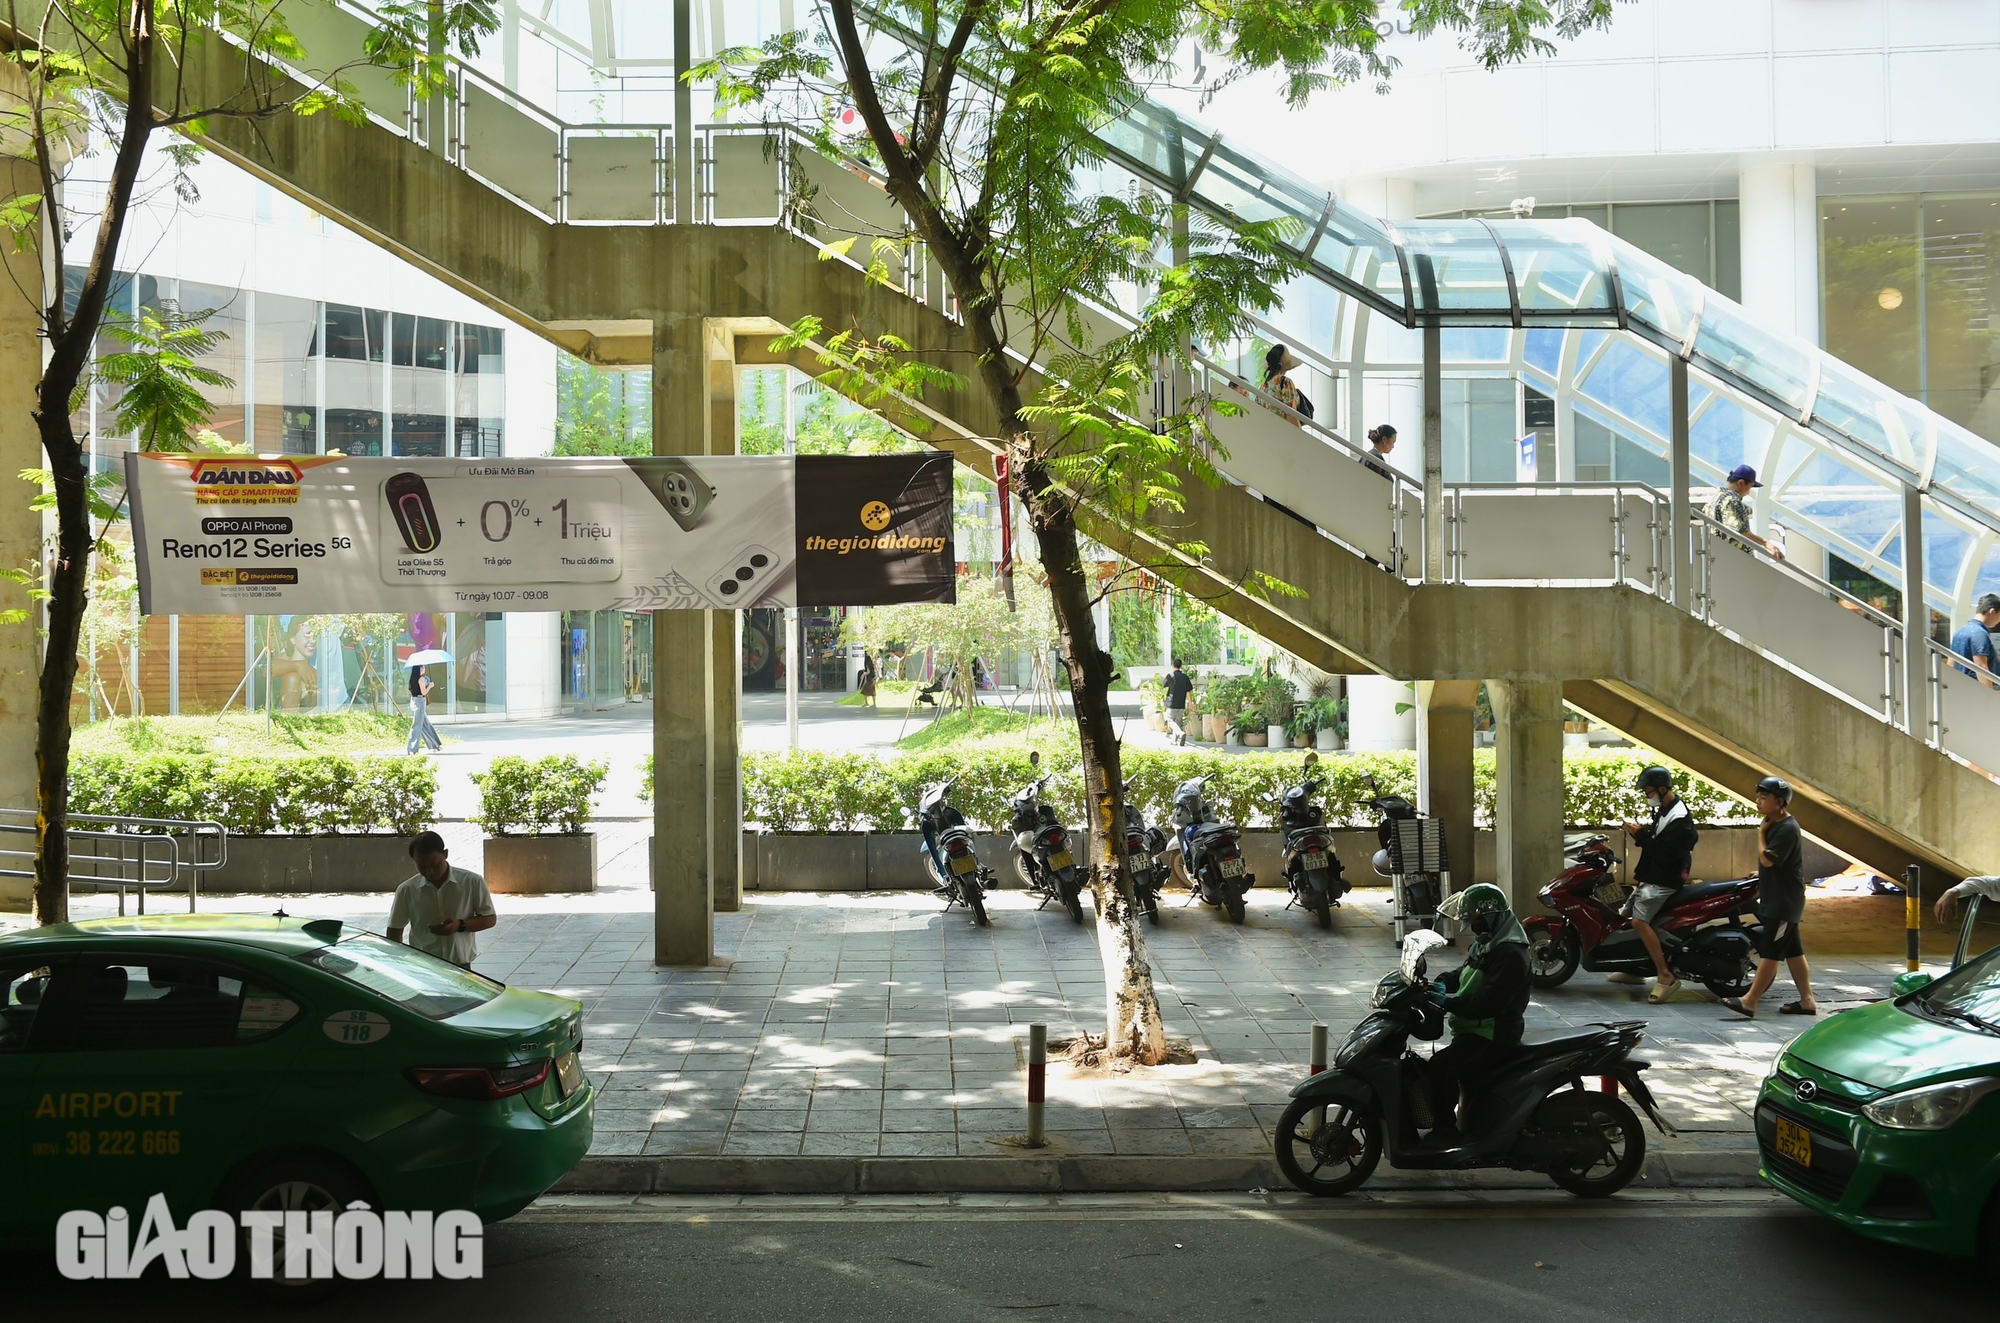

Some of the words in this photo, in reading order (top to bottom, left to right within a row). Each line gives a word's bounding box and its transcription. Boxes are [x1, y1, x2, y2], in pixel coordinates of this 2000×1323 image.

[468, 468, 483, 476] Ưu
[484, 467, 499, 476] Đãi
[500, 467, 516, 476] Mở
[517, 468, 535, 476] Bán
[242, 488, 298, 496] SMARTPHONE
[206, 521, 240, 532] OPPO
[254, 520, 288, 531] Phone
[570, 522, 612, 541] Triệu
[162, 538, 248, 558] Reno12
[254, 538, 326, 558] Series
[331, 537, 352, 549] 5G
[806, 534, 946, 554] thegioididong
[398, 558, 412, 566] Loa
[413, 558, 432, 566] Olike
[484, 557, 496, 565] Trả
[497, 557, 512, 566] góp
[561, 557, 576, 565] Thu
[576, 557, 586, 565] cũ
[588, 556, 599, 565] đổi
[600, 557, 614, 565] mới
[203, 570, 219, 580] ĐẶC
[220, 570, 234, 580] BIỆT
[398, 568, 415, 576] Thời
[416, 568, 446, 578] Thượng
[454, 592, 467, 600] Từ
[468, 592, 490, 602] ngày
[492, 592, 516, 600] 10.07
[522, 591, 549, 600] 09.08
[1478, 896, 1499, 910] Grab
[350, 1012, 368, 1021] SB
[342, 1024, 371, 1041] 118
[520, 1042, 540, 1052] CITY
[35, 1091, 184, 1119] AIRPORT
[65, 1130, 92, 1156] 38
[96, 1130, 136, 1156] 222
[142, 1130, 182, 1156] 666
